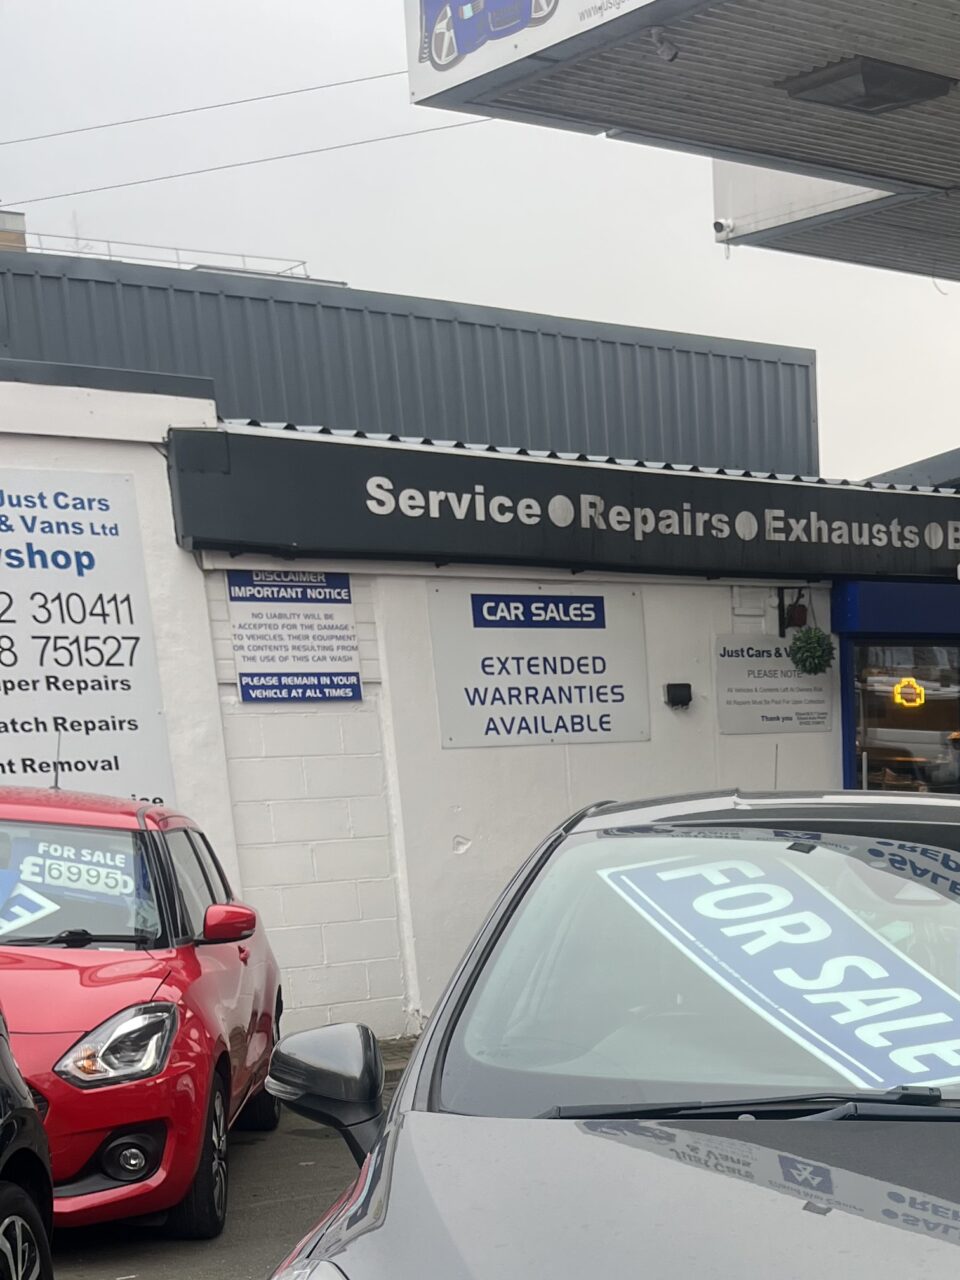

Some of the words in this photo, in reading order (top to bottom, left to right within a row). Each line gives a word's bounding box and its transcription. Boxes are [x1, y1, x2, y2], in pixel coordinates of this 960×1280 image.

[53, 491, 110, 512] Cars
[366, 476, 542, 525] Service
[580, 494, 731, 541] Repairs
[764, 508, 919, 548] Exhausts
[0, 514, 15, 533] &
[19, 515, 84, 535] Vans
[90, 523, 119, 537] Ltd
[0, 542, 96, 577] shop
[252, 571, 326, 582] DISCLAIMER
[230, 586, 303, 598] IMPORTANT
[307, 588, 350, 600] NOTICE
[30, 591, 135, 625] 310411
[251, 612, 264, 620] NO
[482, 602, 525, 621] CAR
[530, 602, 596, 622] SALES
[238, 623, 279, 631] ACCEPTED
[281, 623, 298, 631] FOR
[31, 635, 141, 667] 751527
[719, 647, 745, 658] Just
[746, 647, 772, 658] Cars
[774, 647, 783, 658] &
[481, 656, 606, 676] EXTENDED
[747, 669, 779, 678] PLEASE
[780, 669, 803, 678] NOTE
[0, 679, 40, 696] per
[45, 675, 132, 695] Repairs
[241, 676, 279, 685] PLEASE
[281, 676, 318, 685] REMAIN
[320, 676, 330, 685] IN
[332, 676, 357, 685] YOUR
[249, 689, 289, 698] VEHICLE
[291, 689, 302, 698] AT
[305, 689, 322, 697] ALL
[324, 688, 353, 697] TIMES
[464, 685, 625, 706] WARRANTIES
[53, 716, 139, 735] Repairs
[484, 713, 612, 735] AVAILABLE
[21, 756, 120, 774] Removal
[38, 842, 76, 860] FOR
[81, 849, 126, 867] SALE
[656, 859, 832, 956] FOR
